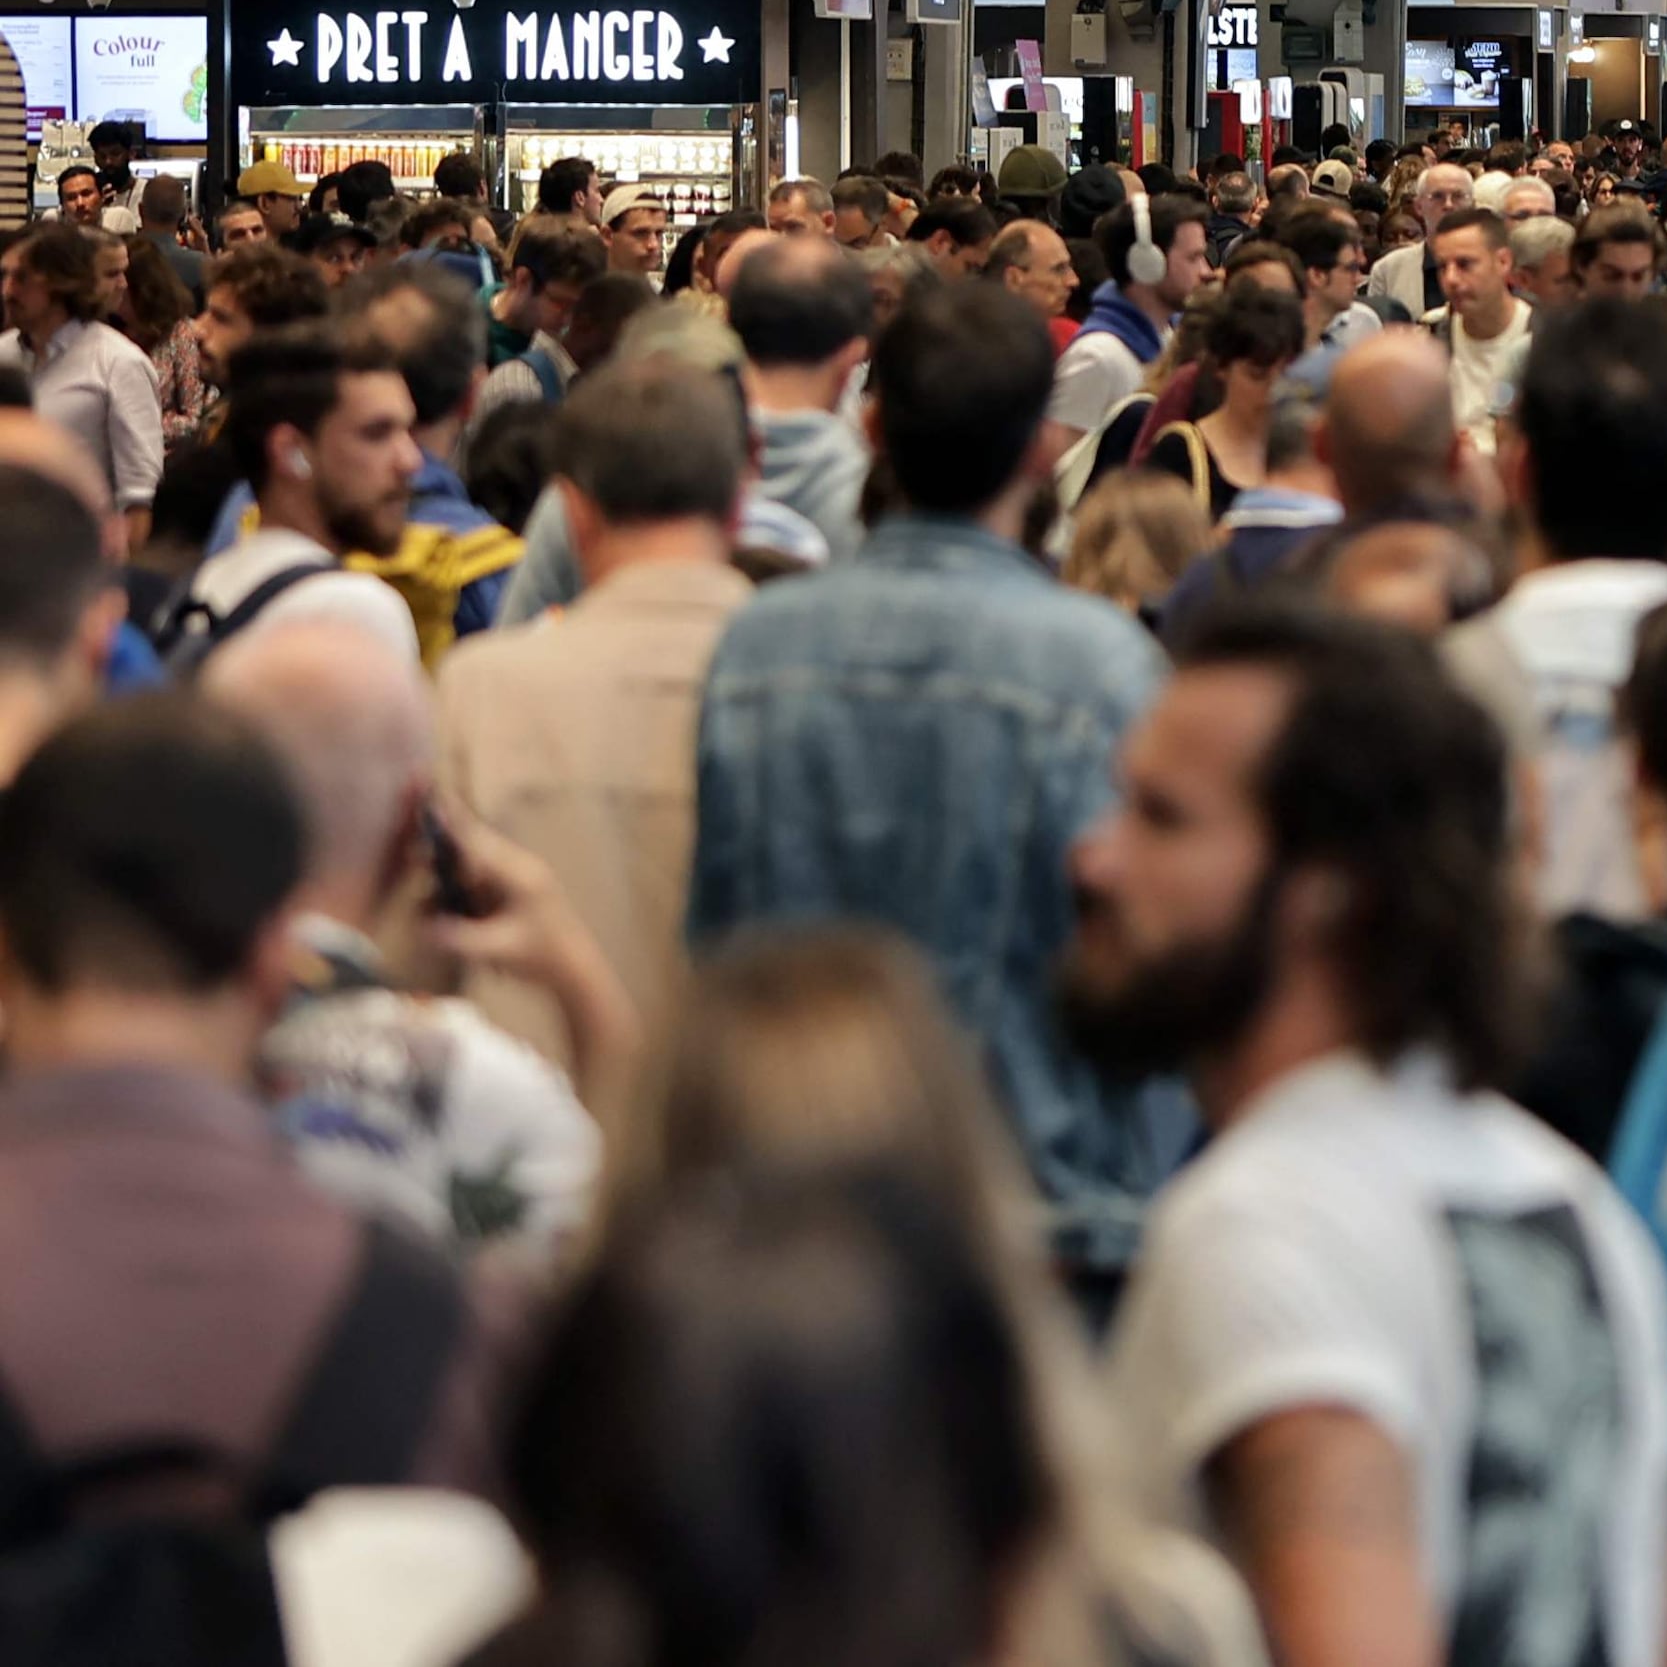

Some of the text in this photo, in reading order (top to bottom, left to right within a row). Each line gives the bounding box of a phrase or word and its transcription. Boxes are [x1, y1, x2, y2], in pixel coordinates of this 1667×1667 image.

[93, 34, 165, 57] Colour
[317, 10, 684, 82] PRET A MANGER
[130, 54, 155, 67] full
